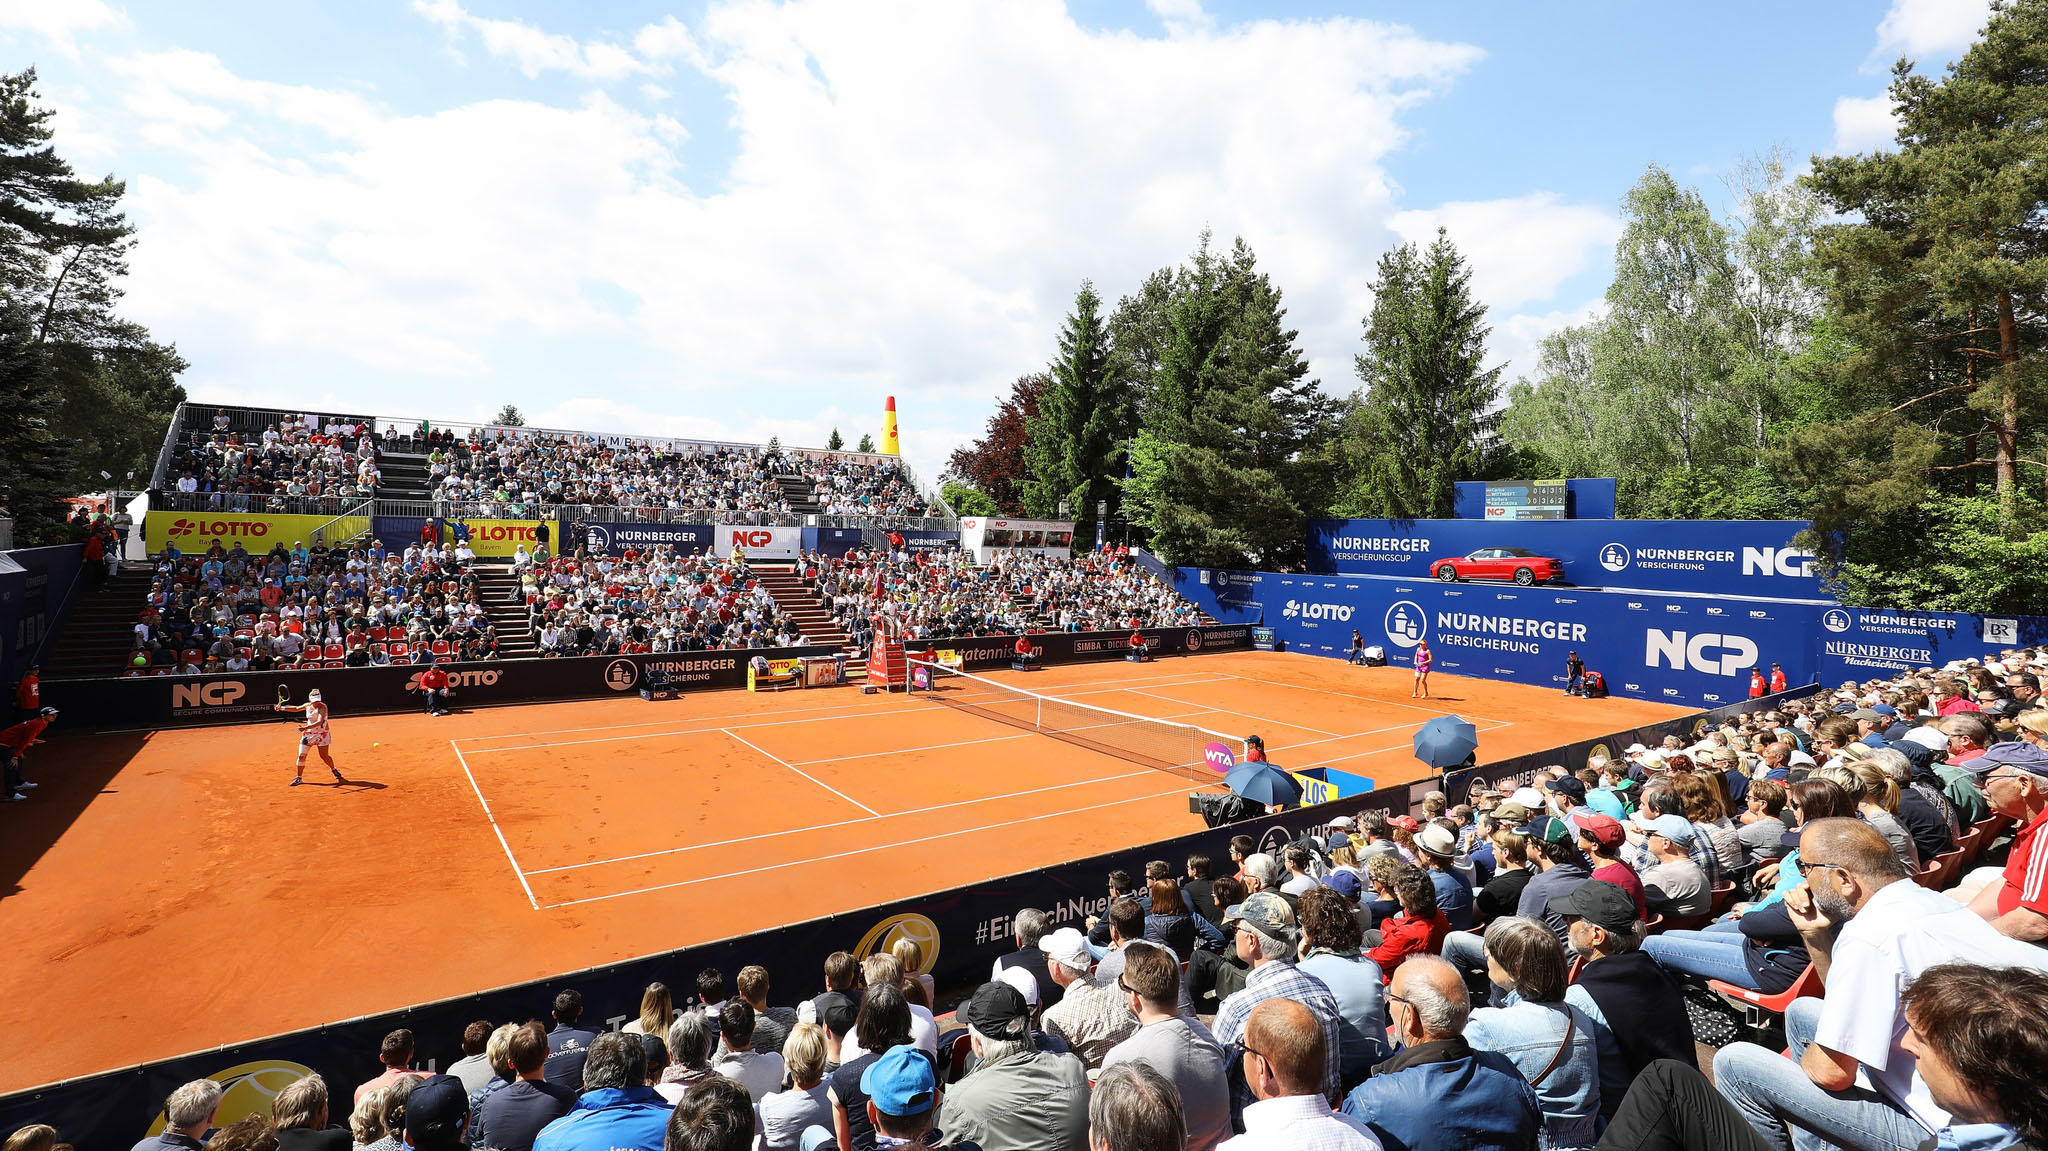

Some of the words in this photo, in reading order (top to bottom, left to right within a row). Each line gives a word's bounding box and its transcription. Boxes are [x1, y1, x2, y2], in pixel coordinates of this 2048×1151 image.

[616, 530, 696, 542] NÜRNBERGER
[732, 531, 772, 548] NCP
[908, 538, 947, 546] NÜRNBERG
[1332, 537, 1430, 552] NÜRNBERGER
[1333, 553, 1411, 562] VERSICHERUNGSCUP
[1636, 548, 1735, 562] NÜRNBERGER
[1636, 561, 1705, 571] VERSICHERUNG
[1438, 611, 1587, 642] NÜRNBERGER
[1860, 614, 1956, 629] NÜRNBERGER
[1860, 626, 1927, 636] VERSICHERUNG
[1990, 623, 2010, 636] BR
[1076, 642, 1101, 651] SIMBA
[1438, 633, 1540, 655] VERSICHERUNG
[1825, 641, 1932, 662] NÜRNBERGER
[1645, 628, 1758, 676] NCP
[644, 658, 735, 674] NÜRNBERGER
[1843, 656, 1909, 670] Nachrichten
[448, 670, 498, 688] OTTO
[916, 674, 927, 682] WTA
[172, 681, 246, 708] NCP
[1204, 748, 1233, 767] WTA
